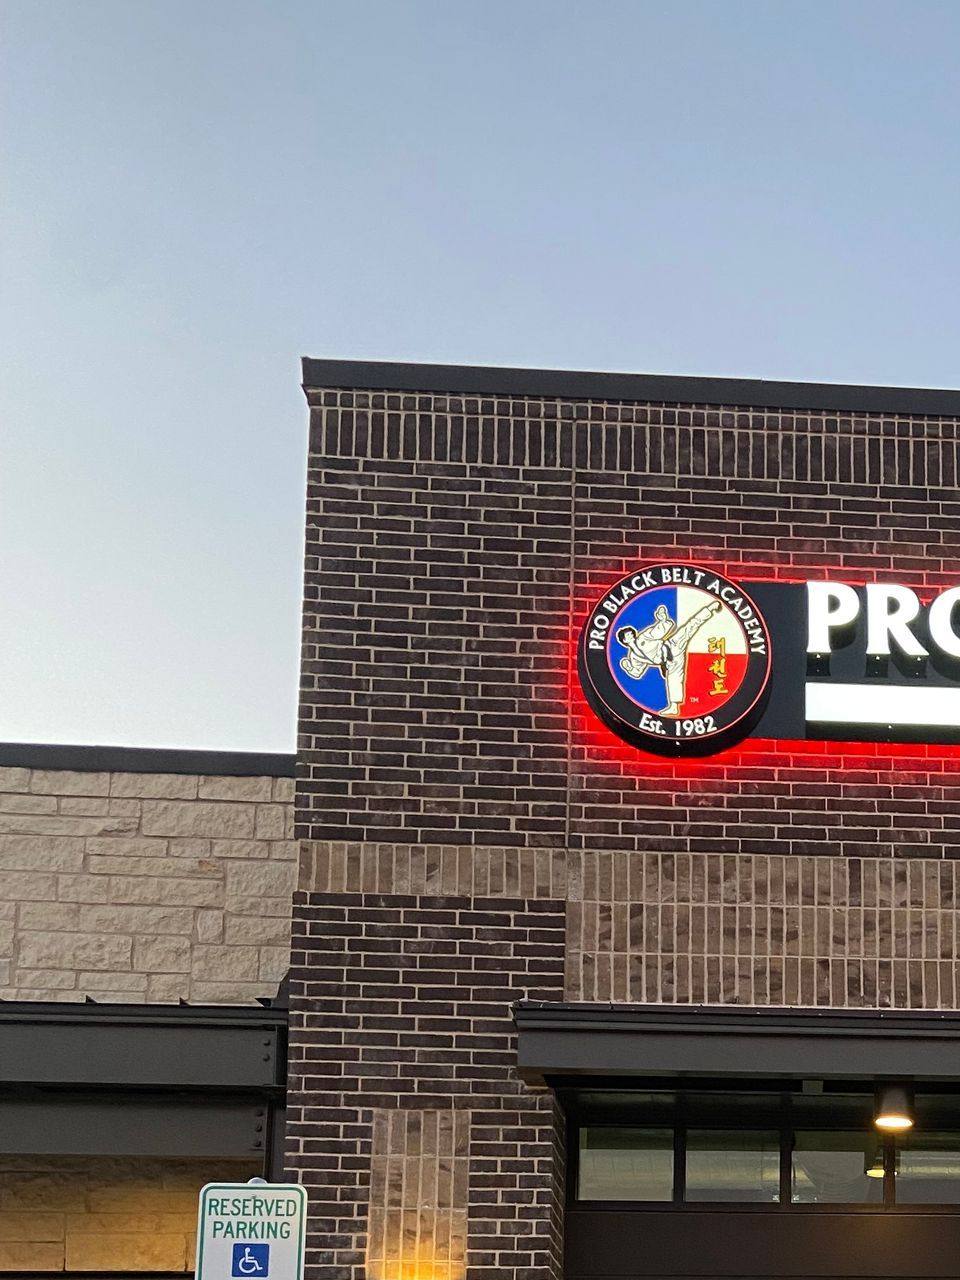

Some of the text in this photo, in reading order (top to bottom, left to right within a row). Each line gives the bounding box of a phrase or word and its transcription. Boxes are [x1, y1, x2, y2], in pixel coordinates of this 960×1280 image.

[589, 568, 766, 655] PRO BLACK BELT ACADEMY
[638, 713, 718, 736] Est. 1982
[208, 1198, 297, 1217] RESERVED
[212, 1221, 291, 1239] PARKING
